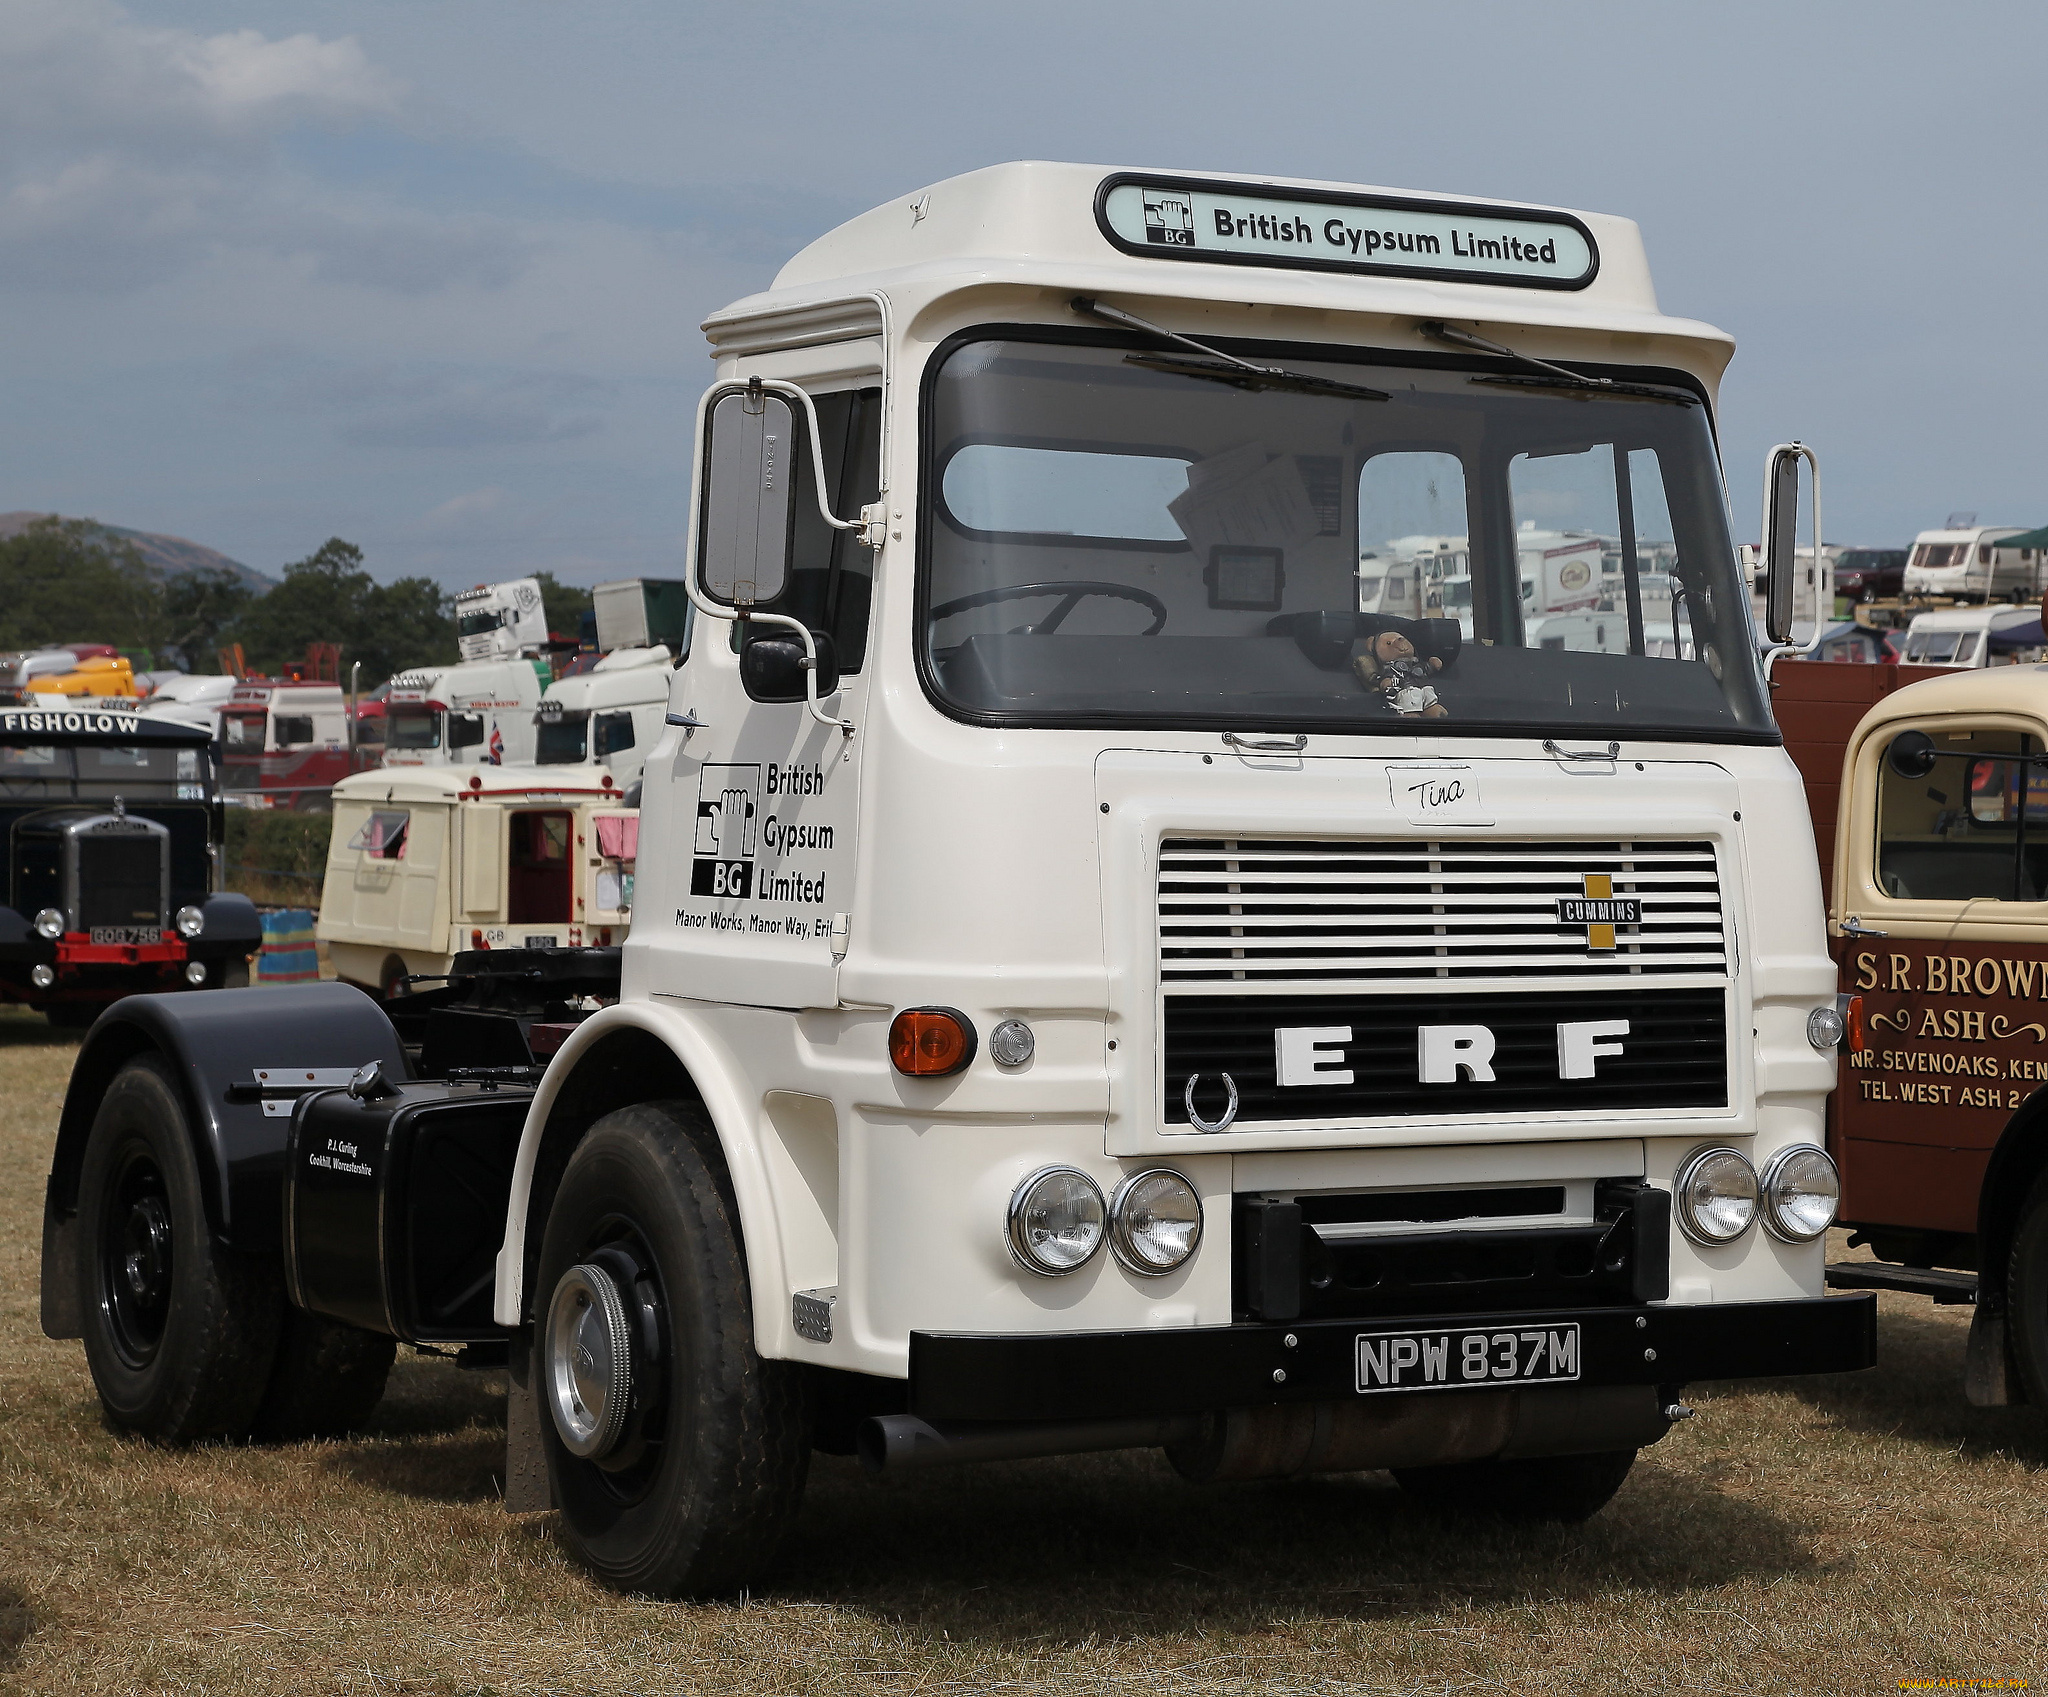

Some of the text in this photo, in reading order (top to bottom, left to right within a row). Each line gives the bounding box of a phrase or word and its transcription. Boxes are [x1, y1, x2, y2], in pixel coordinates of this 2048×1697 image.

[1165, 230, 1187, 244] BG
[1213, 208, 1557, 264] British Gypsum Limited
[4, 713, 139, 733] FISHOLOW
[766, 763, 824, 795] British
[1408, 780, 1465, 809] Tina
[763, 815, 834, 856] Gypsum
[713, 863, 743, 896] BG
[758, 868, 825, 903] Limited
[675, 908, 706, 928] Manor
[710, 911, 745, 934] Works,
[750, 914, 781, 935] Manor
[785, 916, 811, 940] Way,
[1565, 902, 1635, 920] CUMMINS
[486, 930, 504, 941] GB
[1917, 1008, 1986, 1040] ASH
[1900, 1083, 1951, 1104] WEST
[1959, 1087, 2001, 1107] ASH
[338, 1141, 358, 1158] Curling
[332, 1157, 372, 1176] Worcestershire
[1360, 1330, 1576, 1386] NPW 837M
